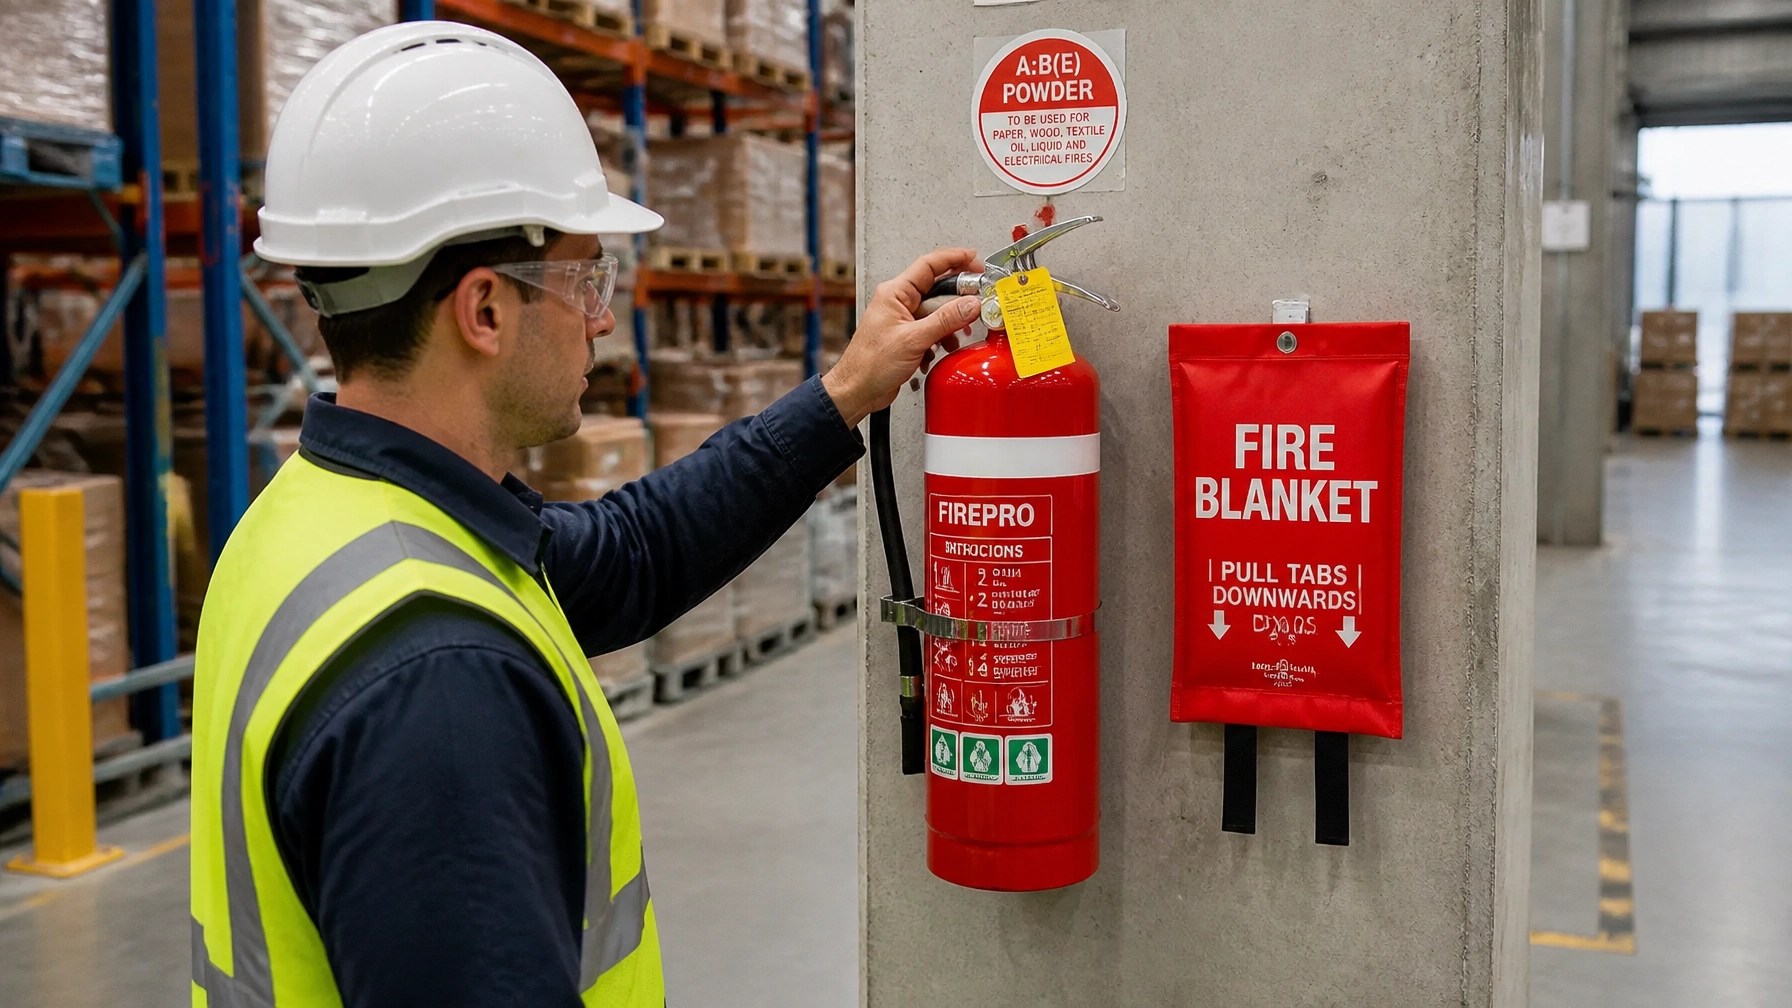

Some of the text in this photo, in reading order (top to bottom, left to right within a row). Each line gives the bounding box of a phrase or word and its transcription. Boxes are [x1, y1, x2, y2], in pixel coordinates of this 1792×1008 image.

[1016, 52, 1081, 78] A:B(E)
[1002, 79, 1094, 104] POWDER
[1008, 112, 1090, 126] TO BE USED FOR
[992, 129, 1026, 141] PAPER,
[1066, 125, 1105, 136] TEXTILE
[1010, 140, 1086, 153] OIL, LIQUID AND
[1065, 153, 1093, 163] FIRES
[1235, 424, 1335, 470] FIRE
[1195, 476, 1378, 523] BLANKET
[938, 501, 1035, 527] FIREPRO
[1221, 561, 1348, 586] PULL TABS
[1213, 586, 1356, 610] DOWNWARDS
